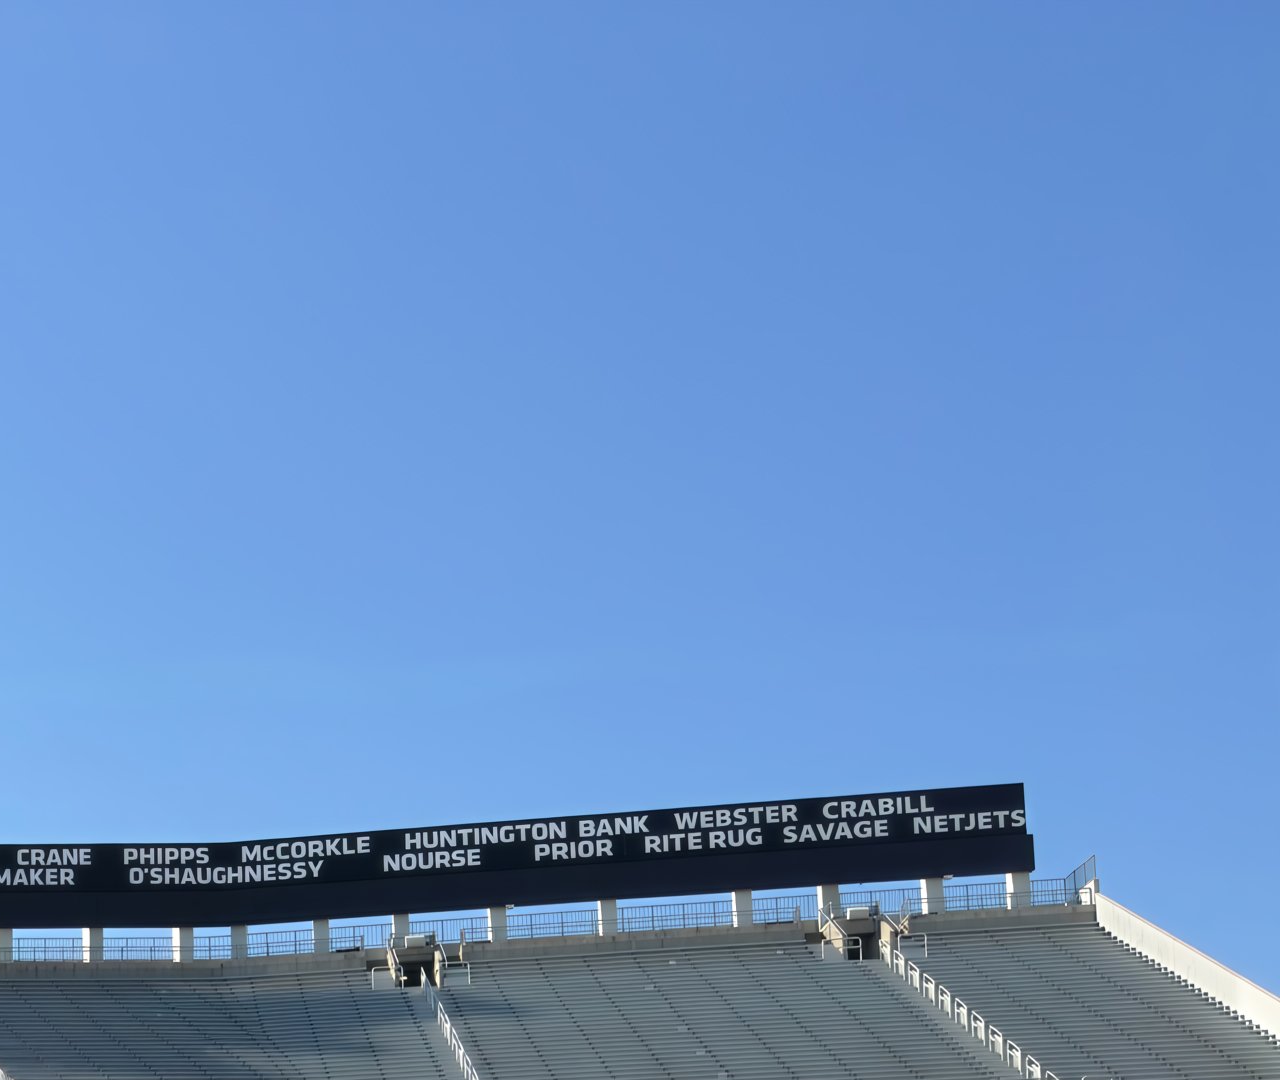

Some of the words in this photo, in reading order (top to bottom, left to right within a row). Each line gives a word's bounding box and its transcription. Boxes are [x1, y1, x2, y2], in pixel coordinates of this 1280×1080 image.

[674, 804, 797, 831] WEBSTER
[823, 795, 934, 820] CRABILL
[404, 820, 566, 850] HUNTINGTON
[578, 815, 649, 837] BANK
[783, 818, 888, 844] SAVAGE
[913, 809, 1026, 834] NETJETS
[241, 836, 371, 863] McCORKLE
[534, 838, 613, 862] PRIOR
[644, 831, 701, 853] RITE
[708, 827, 762, 850] RUG
[17, 849, 91, 865] CRANE
[124, 847, 209, 865] PHIPPS
[383, 848, 481, 872] NOURSE
[129, 860, 323, 885] O'SHAUGHNESSY
